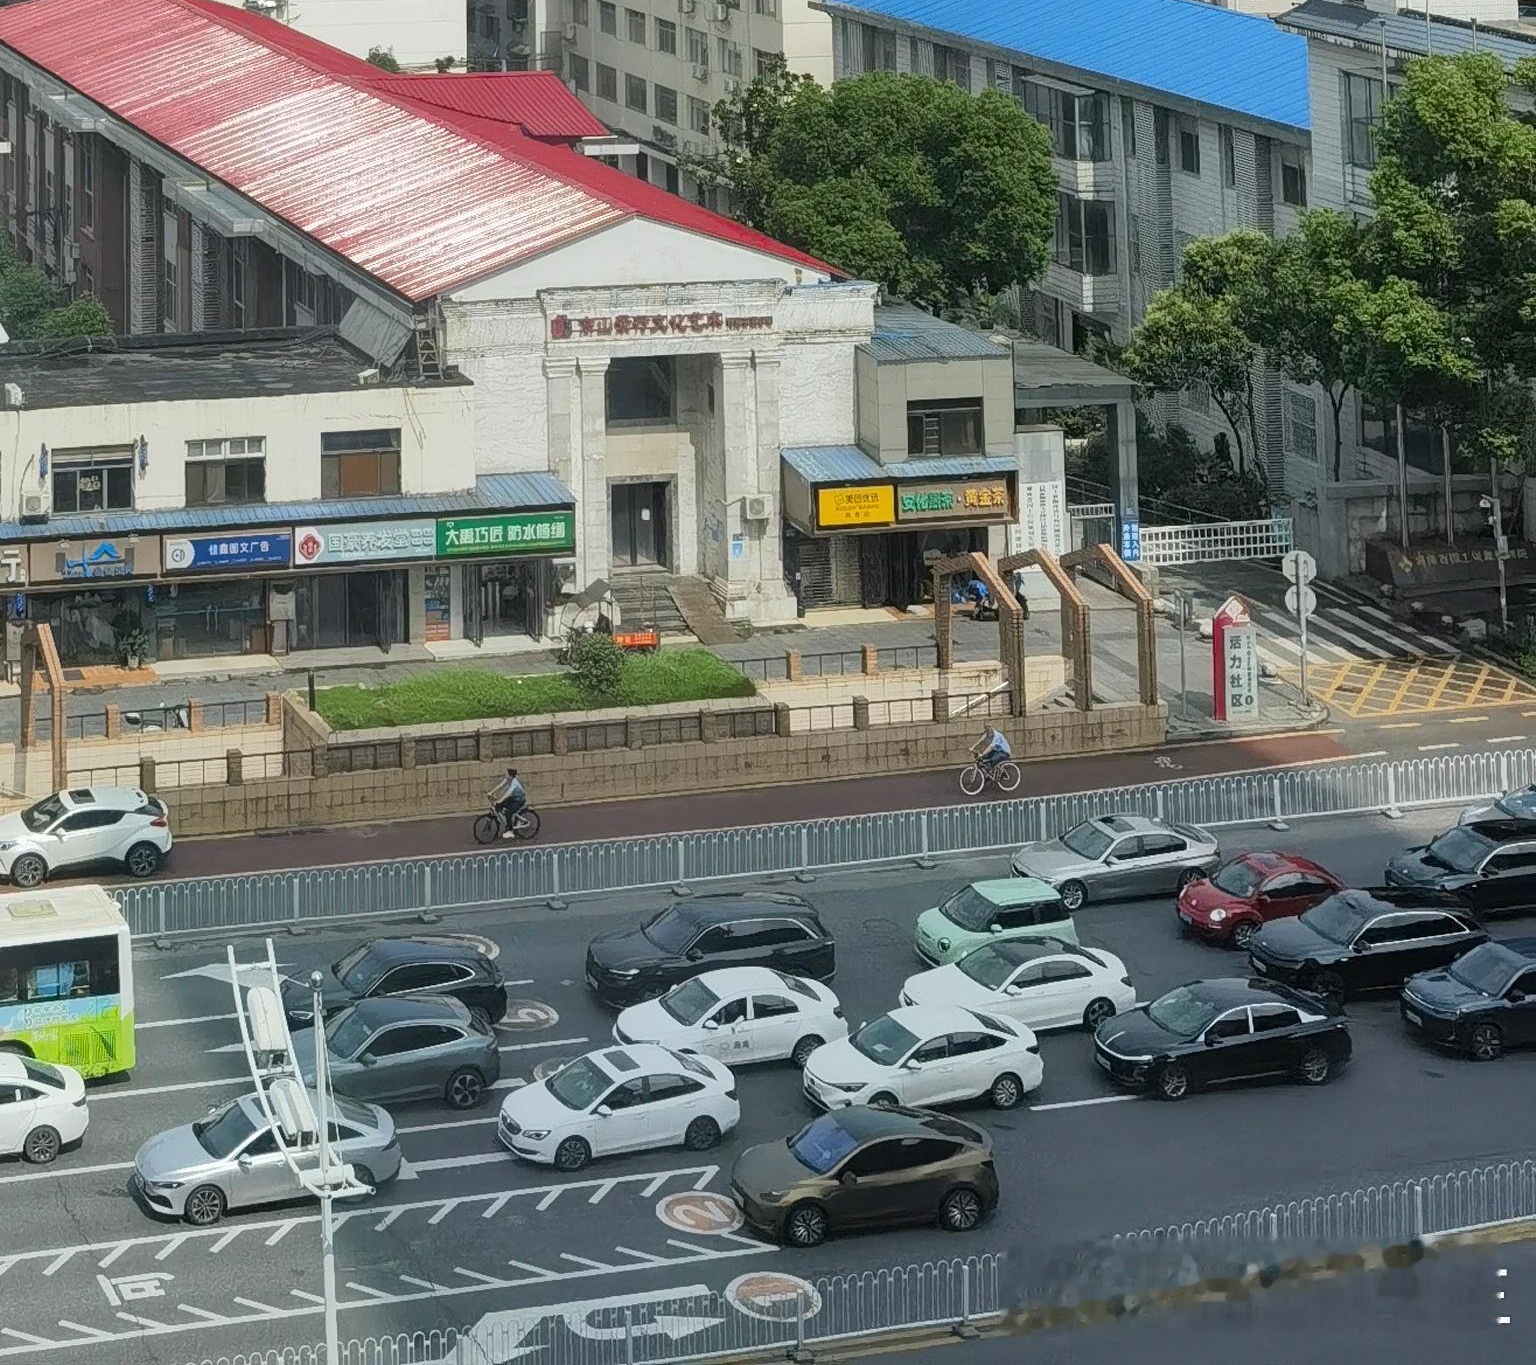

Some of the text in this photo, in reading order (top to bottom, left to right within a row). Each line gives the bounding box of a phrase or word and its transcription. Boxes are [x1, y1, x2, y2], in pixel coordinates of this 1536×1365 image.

[445, 525, 503, 546] 大禹巧匠
[1229, 635, 1244, 707] 活力社区
